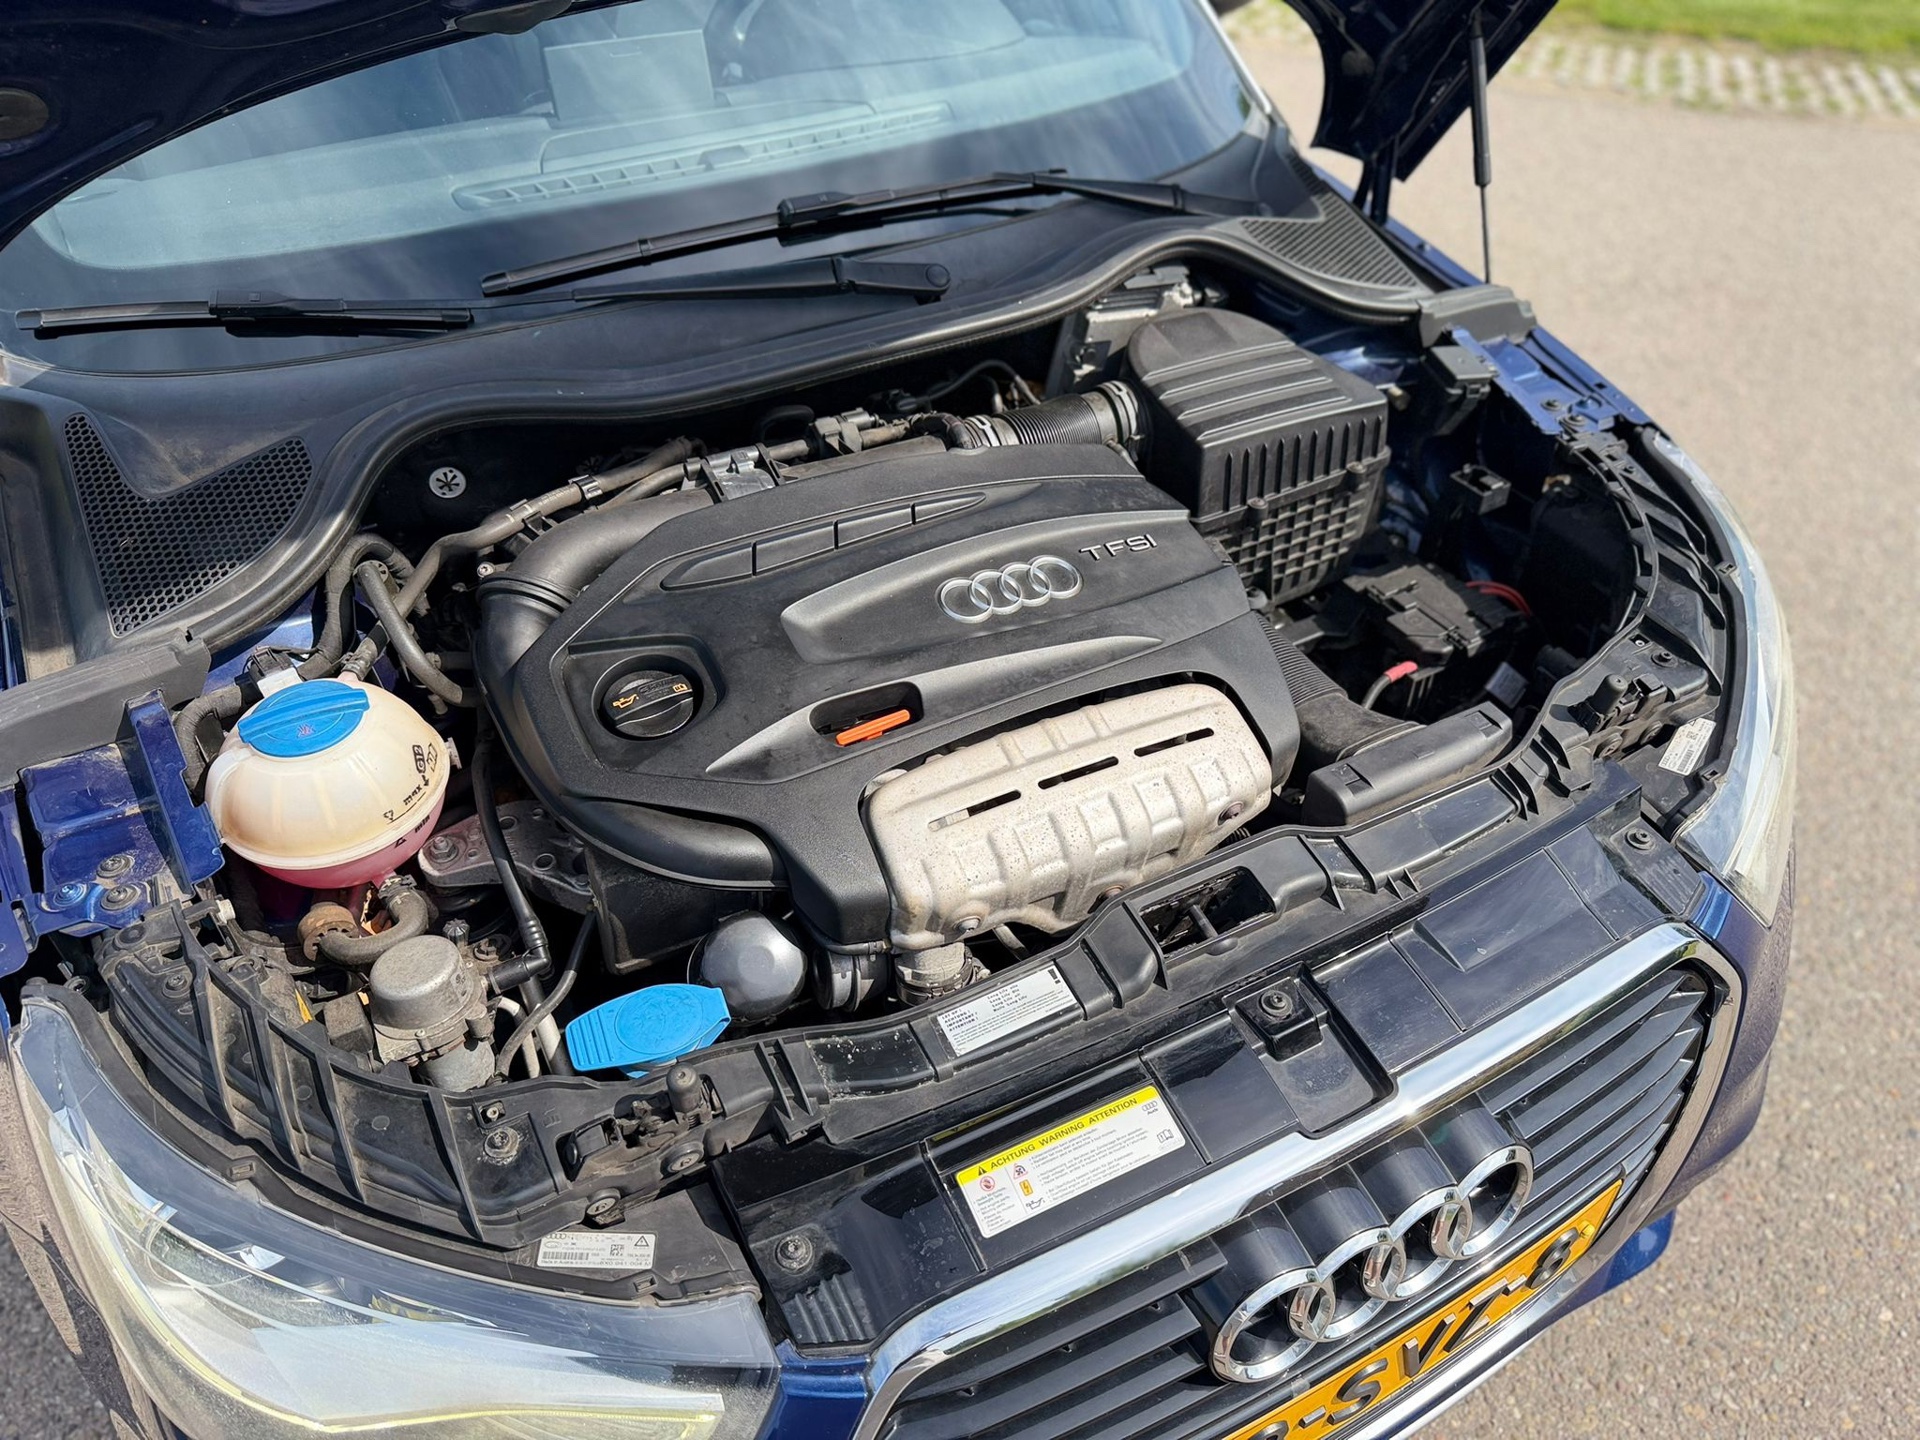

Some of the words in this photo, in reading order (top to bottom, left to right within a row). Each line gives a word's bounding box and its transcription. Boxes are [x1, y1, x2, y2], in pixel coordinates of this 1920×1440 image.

[1079, 533, 1158, 561] TFSI
[403, 784, 422, 805] max
[415, 815, 430, 833] min
[990, 1144, 1035, 1170] ACHTUNG
[1038, 1122, 1085, 1147] WARNING
[1088, 1098, 1138, 1125] ATTENTION
